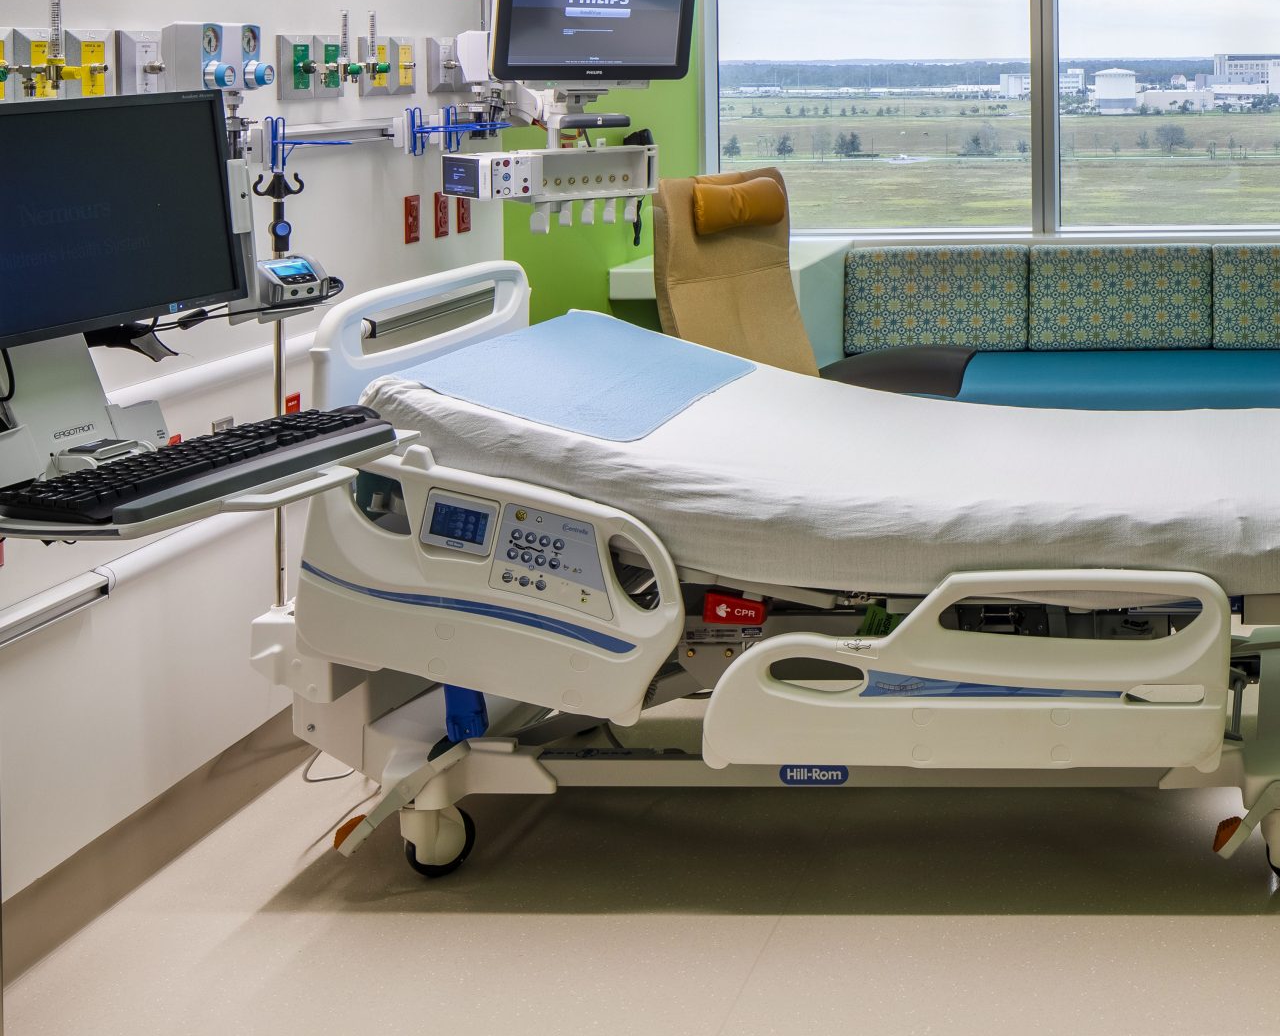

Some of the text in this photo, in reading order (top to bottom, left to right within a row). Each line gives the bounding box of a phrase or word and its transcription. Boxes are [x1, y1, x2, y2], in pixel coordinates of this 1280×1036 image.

[17, 202, 112, 227] Nemours
[60, 242, 101, 261] Health
[103, 235, 152, 256] System
[53, 423, 95, 440] ERGOTRON
[734, 608, 756, 618] CPR
[786, 768, 842, 780] Hill-Rom
